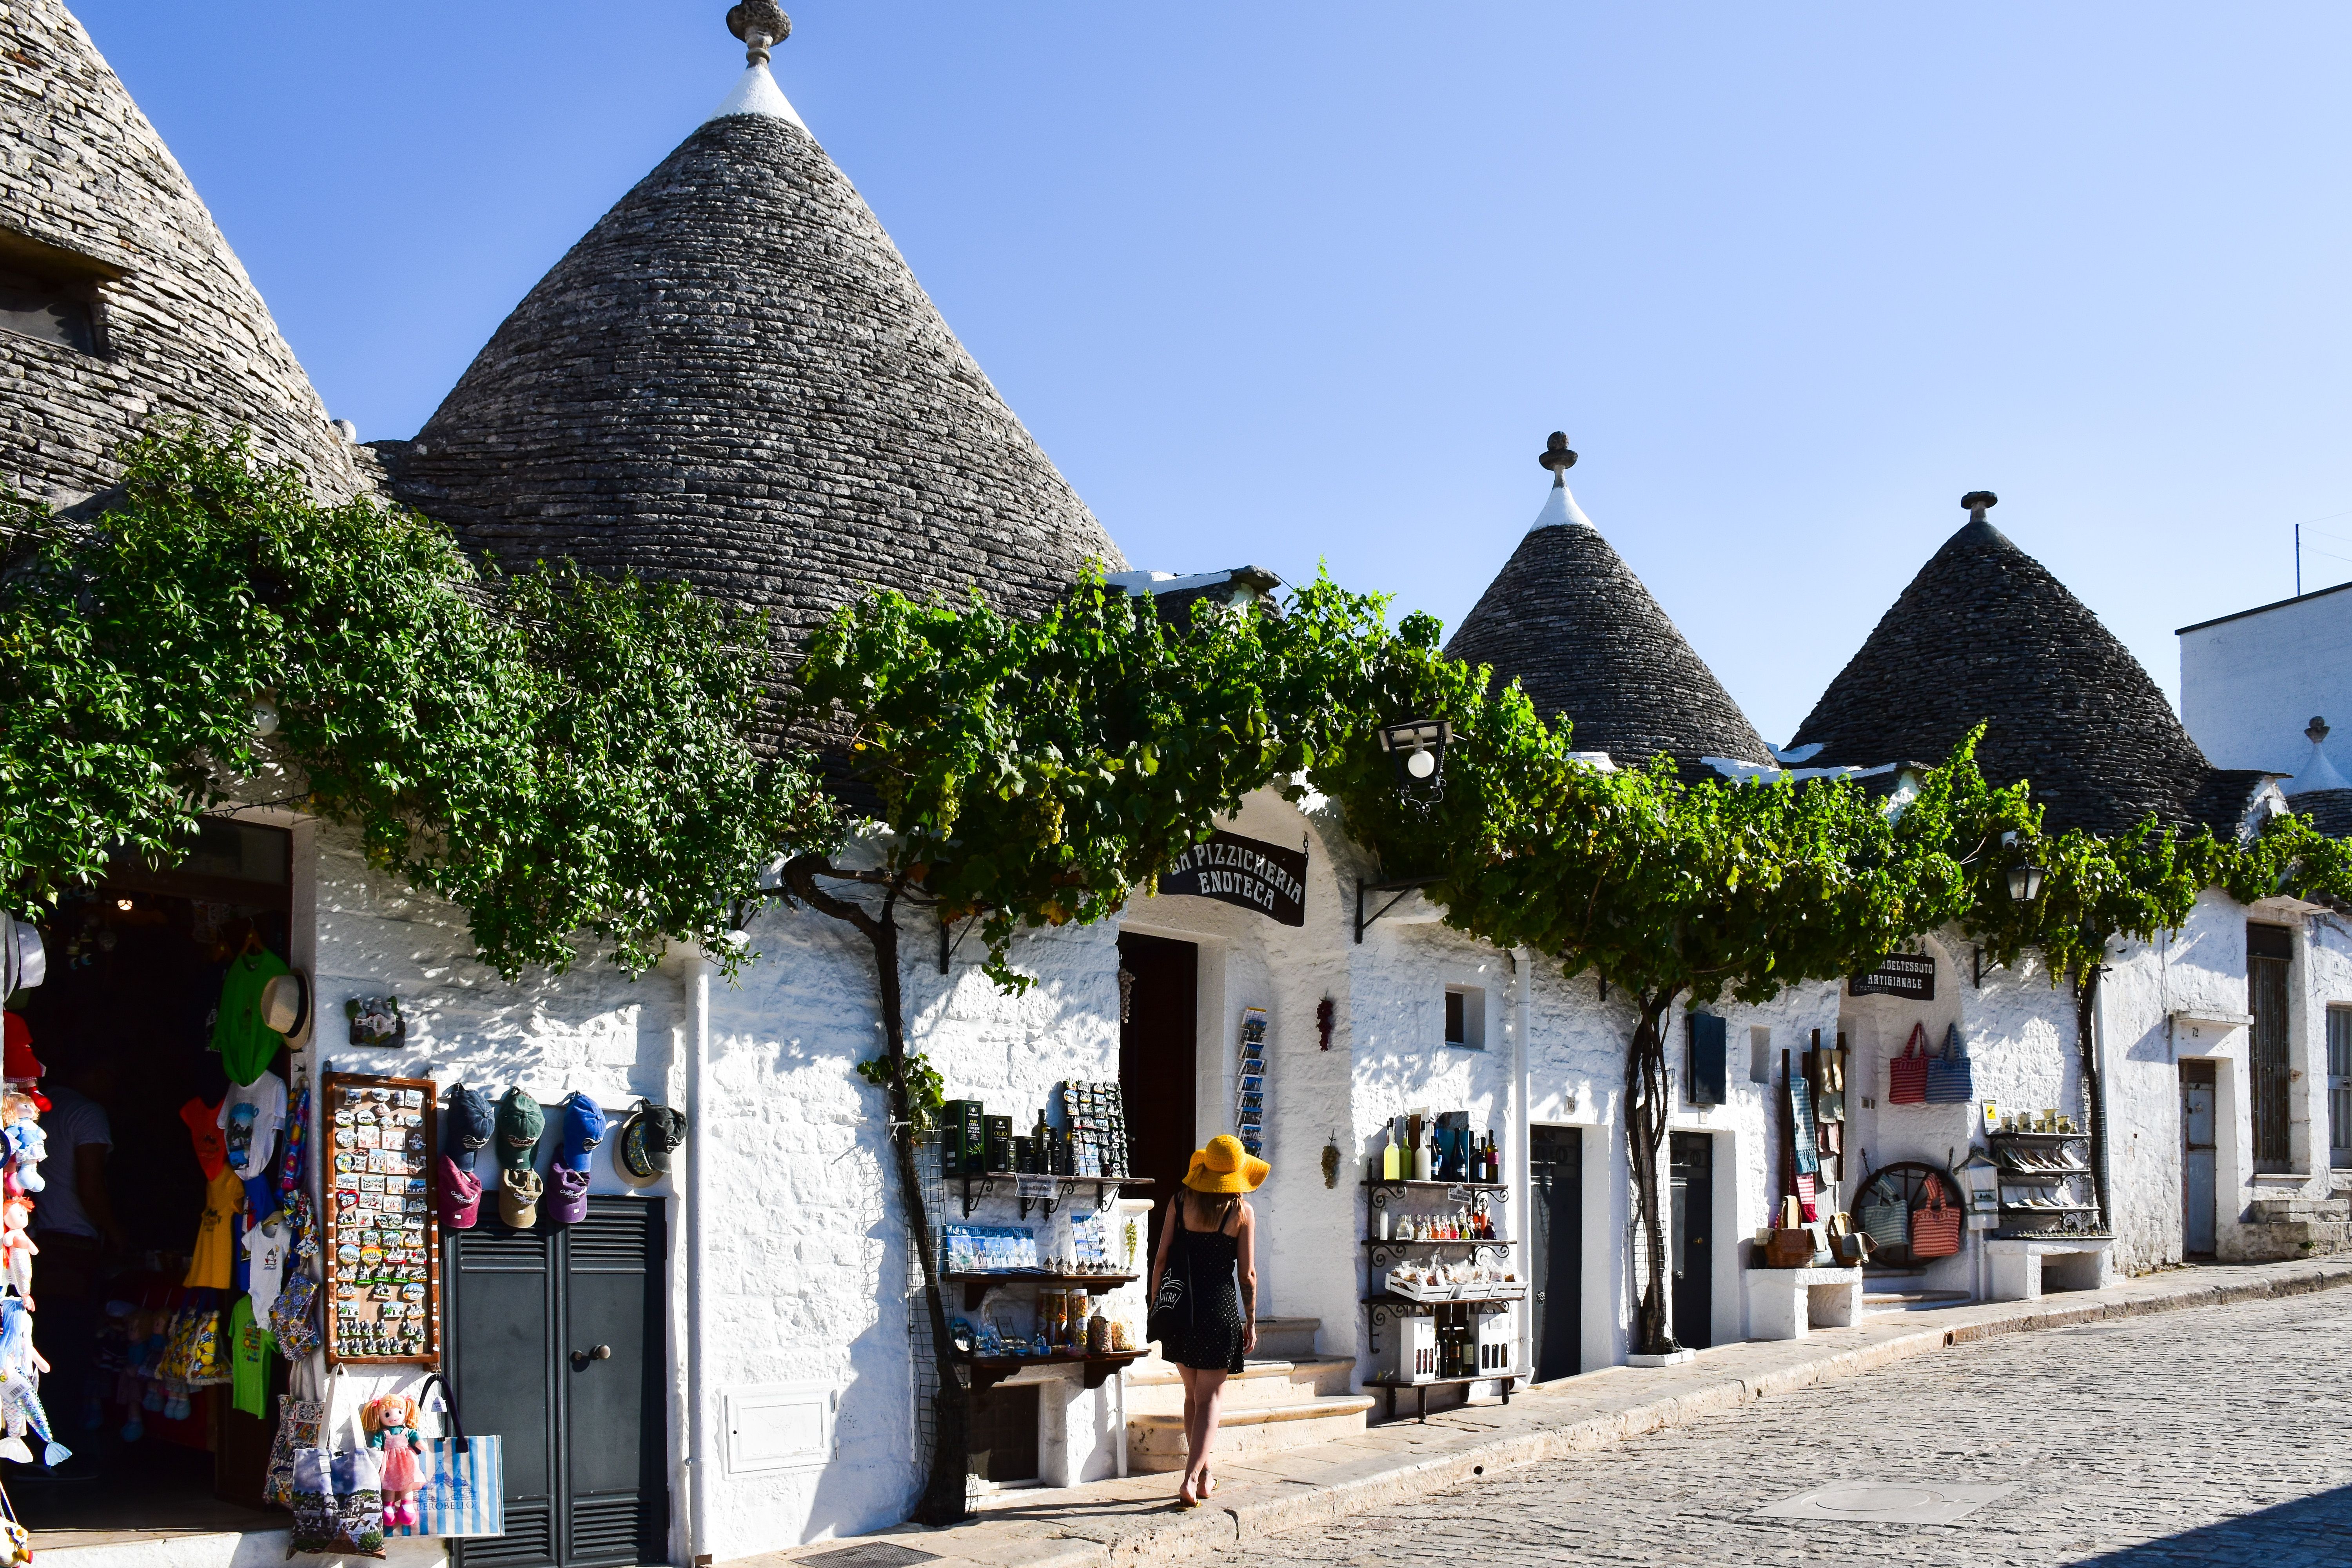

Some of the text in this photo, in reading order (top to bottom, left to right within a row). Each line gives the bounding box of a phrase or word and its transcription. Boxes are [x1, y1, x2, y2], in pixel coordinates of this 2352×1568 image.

[1194, 844, 1302, 905] PIZZICHERIA
[1198, 871, 1274, 911] ENOTECA
[1867, 974, 1922, 989] ARTIGIANALE
[1860, 985, 1889, 994] MATARRESE
[2192, 1027, 2199, 1038] 72
[1568, 1100, 1574, 1109] 66
[417, 1501, 474, 1511] BEROBELLO
